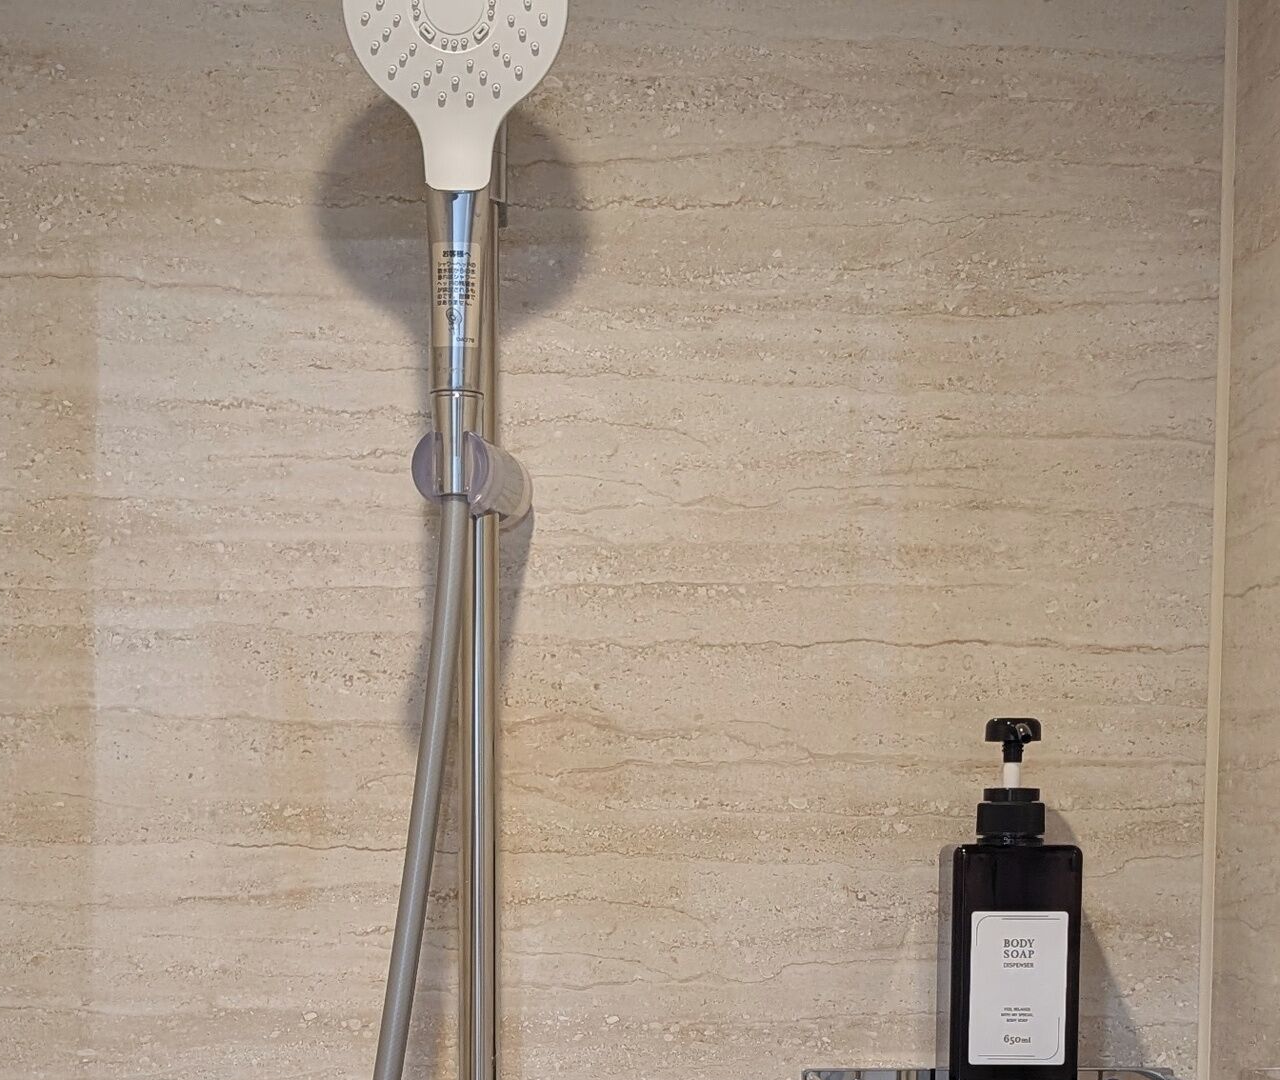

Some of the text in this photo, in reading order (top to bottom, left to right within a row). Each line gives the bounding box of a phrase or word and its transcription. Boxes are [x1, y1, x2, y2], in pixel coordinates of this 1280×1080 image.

[1004, 939, 1035, 948] BODY
[1004, 950, 1035, 958] SOAP
[1004, 1034, 1031, 1045] 650ml
